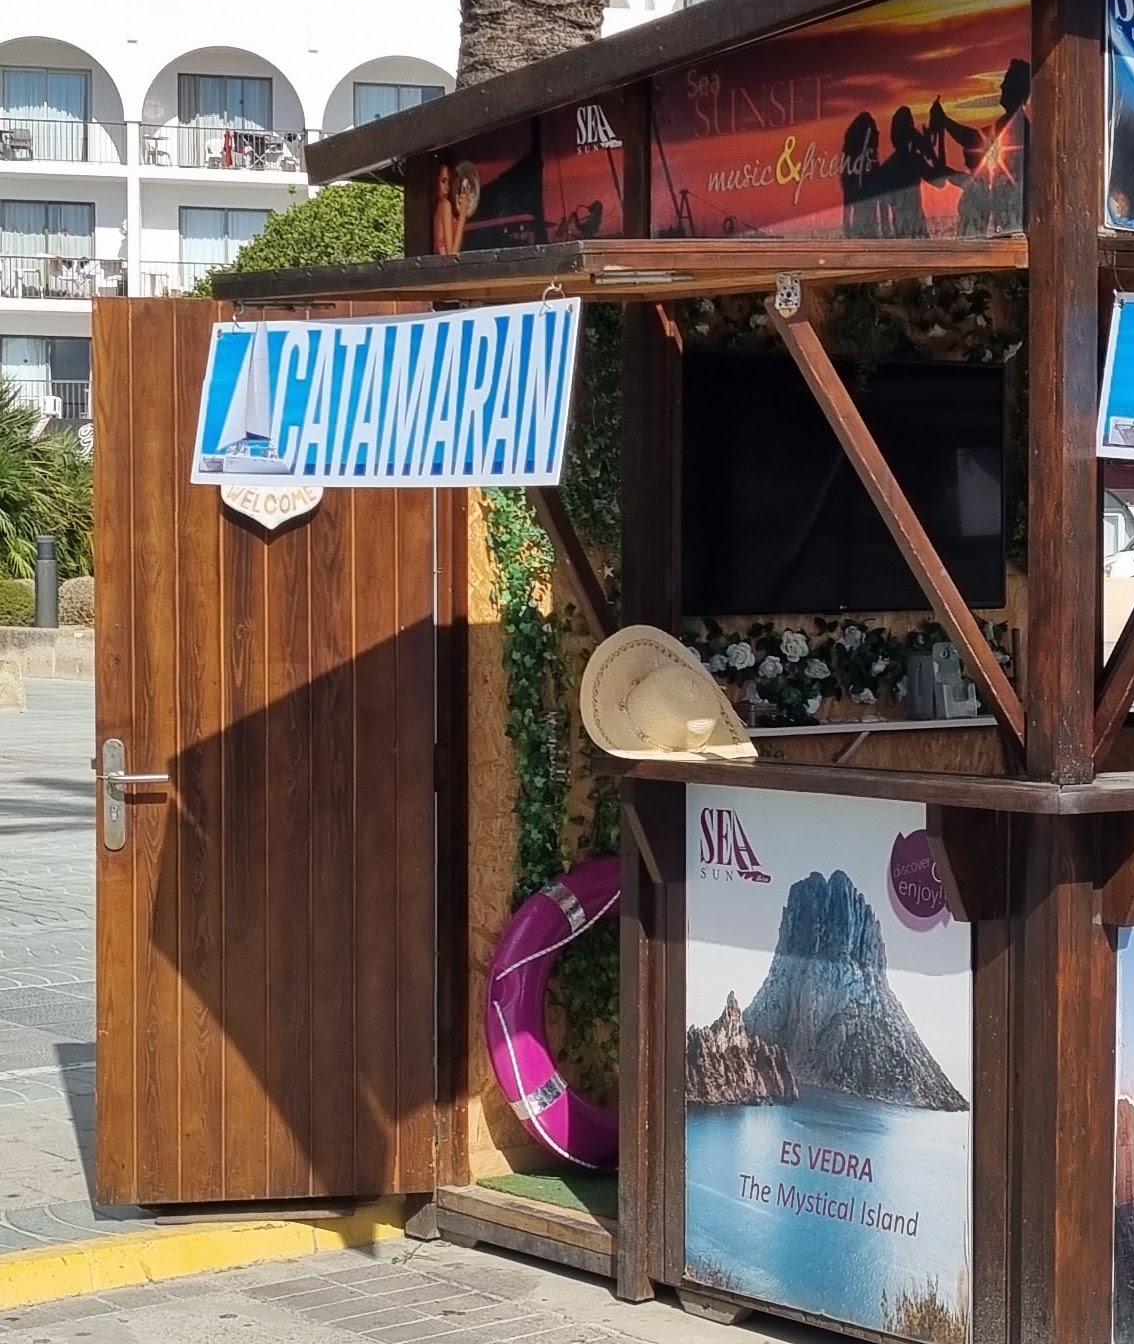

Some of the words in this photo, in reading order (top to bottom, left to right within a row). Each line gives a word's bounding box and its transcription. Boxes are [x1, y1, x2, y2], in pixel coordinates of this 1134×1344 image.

[687, 69, 720, 98] Sea
[576, 105, 617, 145] SEA
[708, 159, 774, 192] music
[776, 135, 801, 185] &
[793, 126, 879, 205] friends
[273, 310, 565, 476] CATAMARAN
[226, 485, 317, 515] WELCOME
[700, 806, 762, 871] SEA
[700, 867, 734, 882] SUN
[898, 880, 943, 909] enjoy!
[780, 1140, 802, 1167] ES
[807, 1145, 874, 1183] VEDRA
[739, 1173, 771, 1203] The
[777, 1182, 855, 1223] Mystical
[860, 1200, 919, 1237] Island
